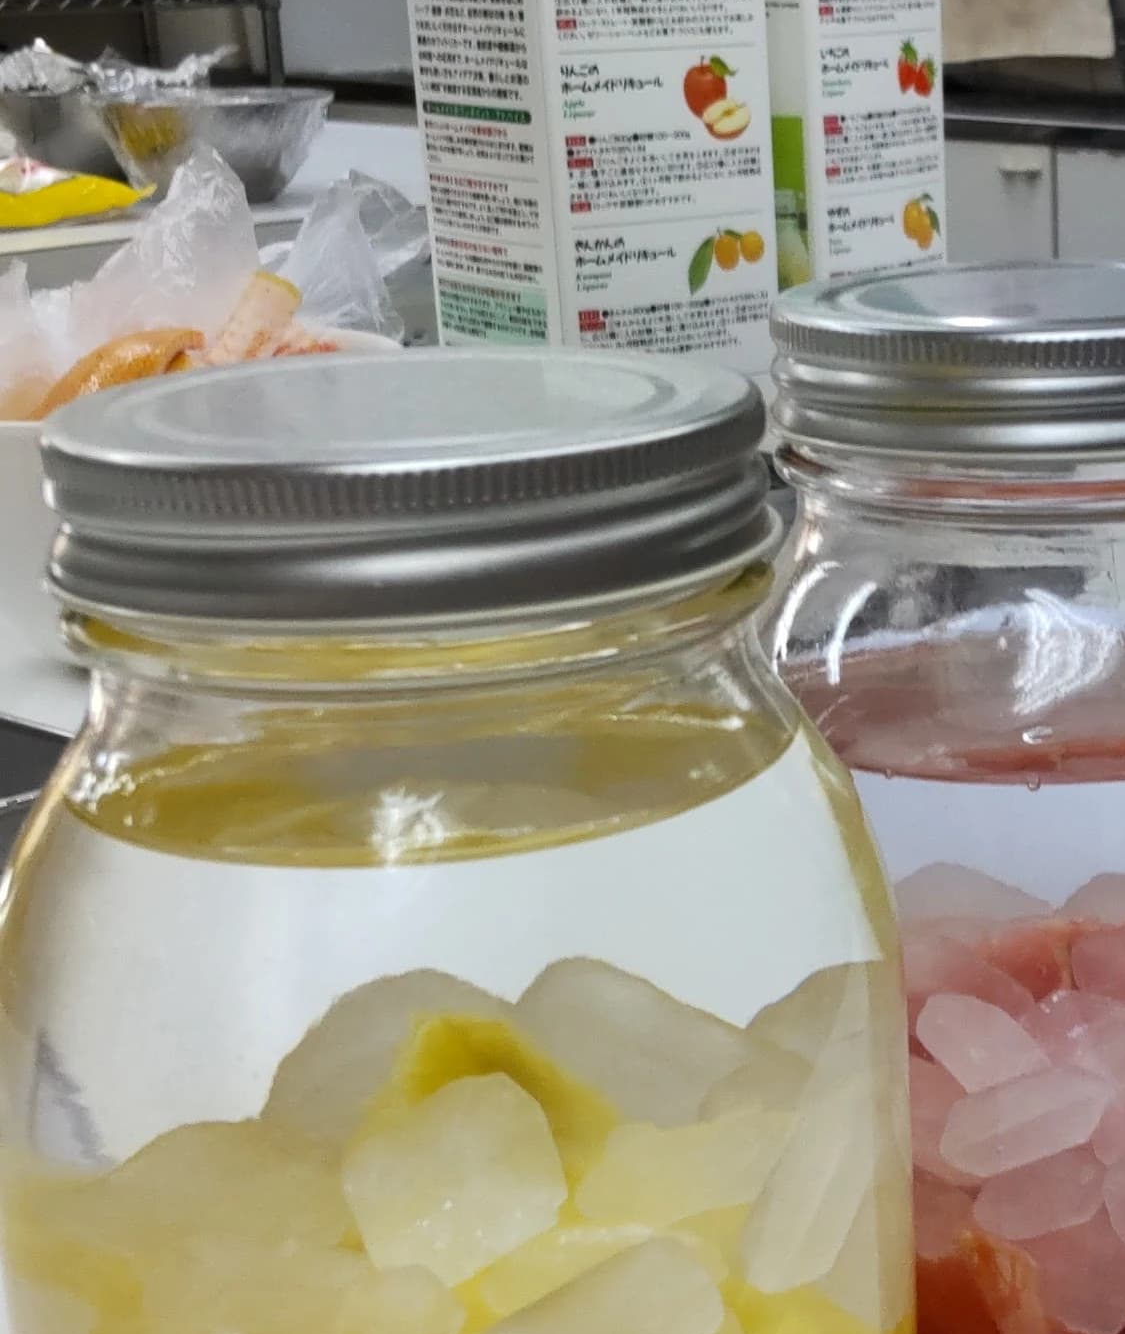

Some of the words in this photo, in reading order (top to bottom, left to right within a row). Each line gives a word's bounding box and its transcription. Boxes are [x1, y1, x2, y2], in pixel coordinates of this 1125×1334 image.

[560, 64, 599, 78] りんごの
[561, 77, 664, 95] ホームメイドリキュール
[576, 248, 676, 267] ホームメイドリキュール
